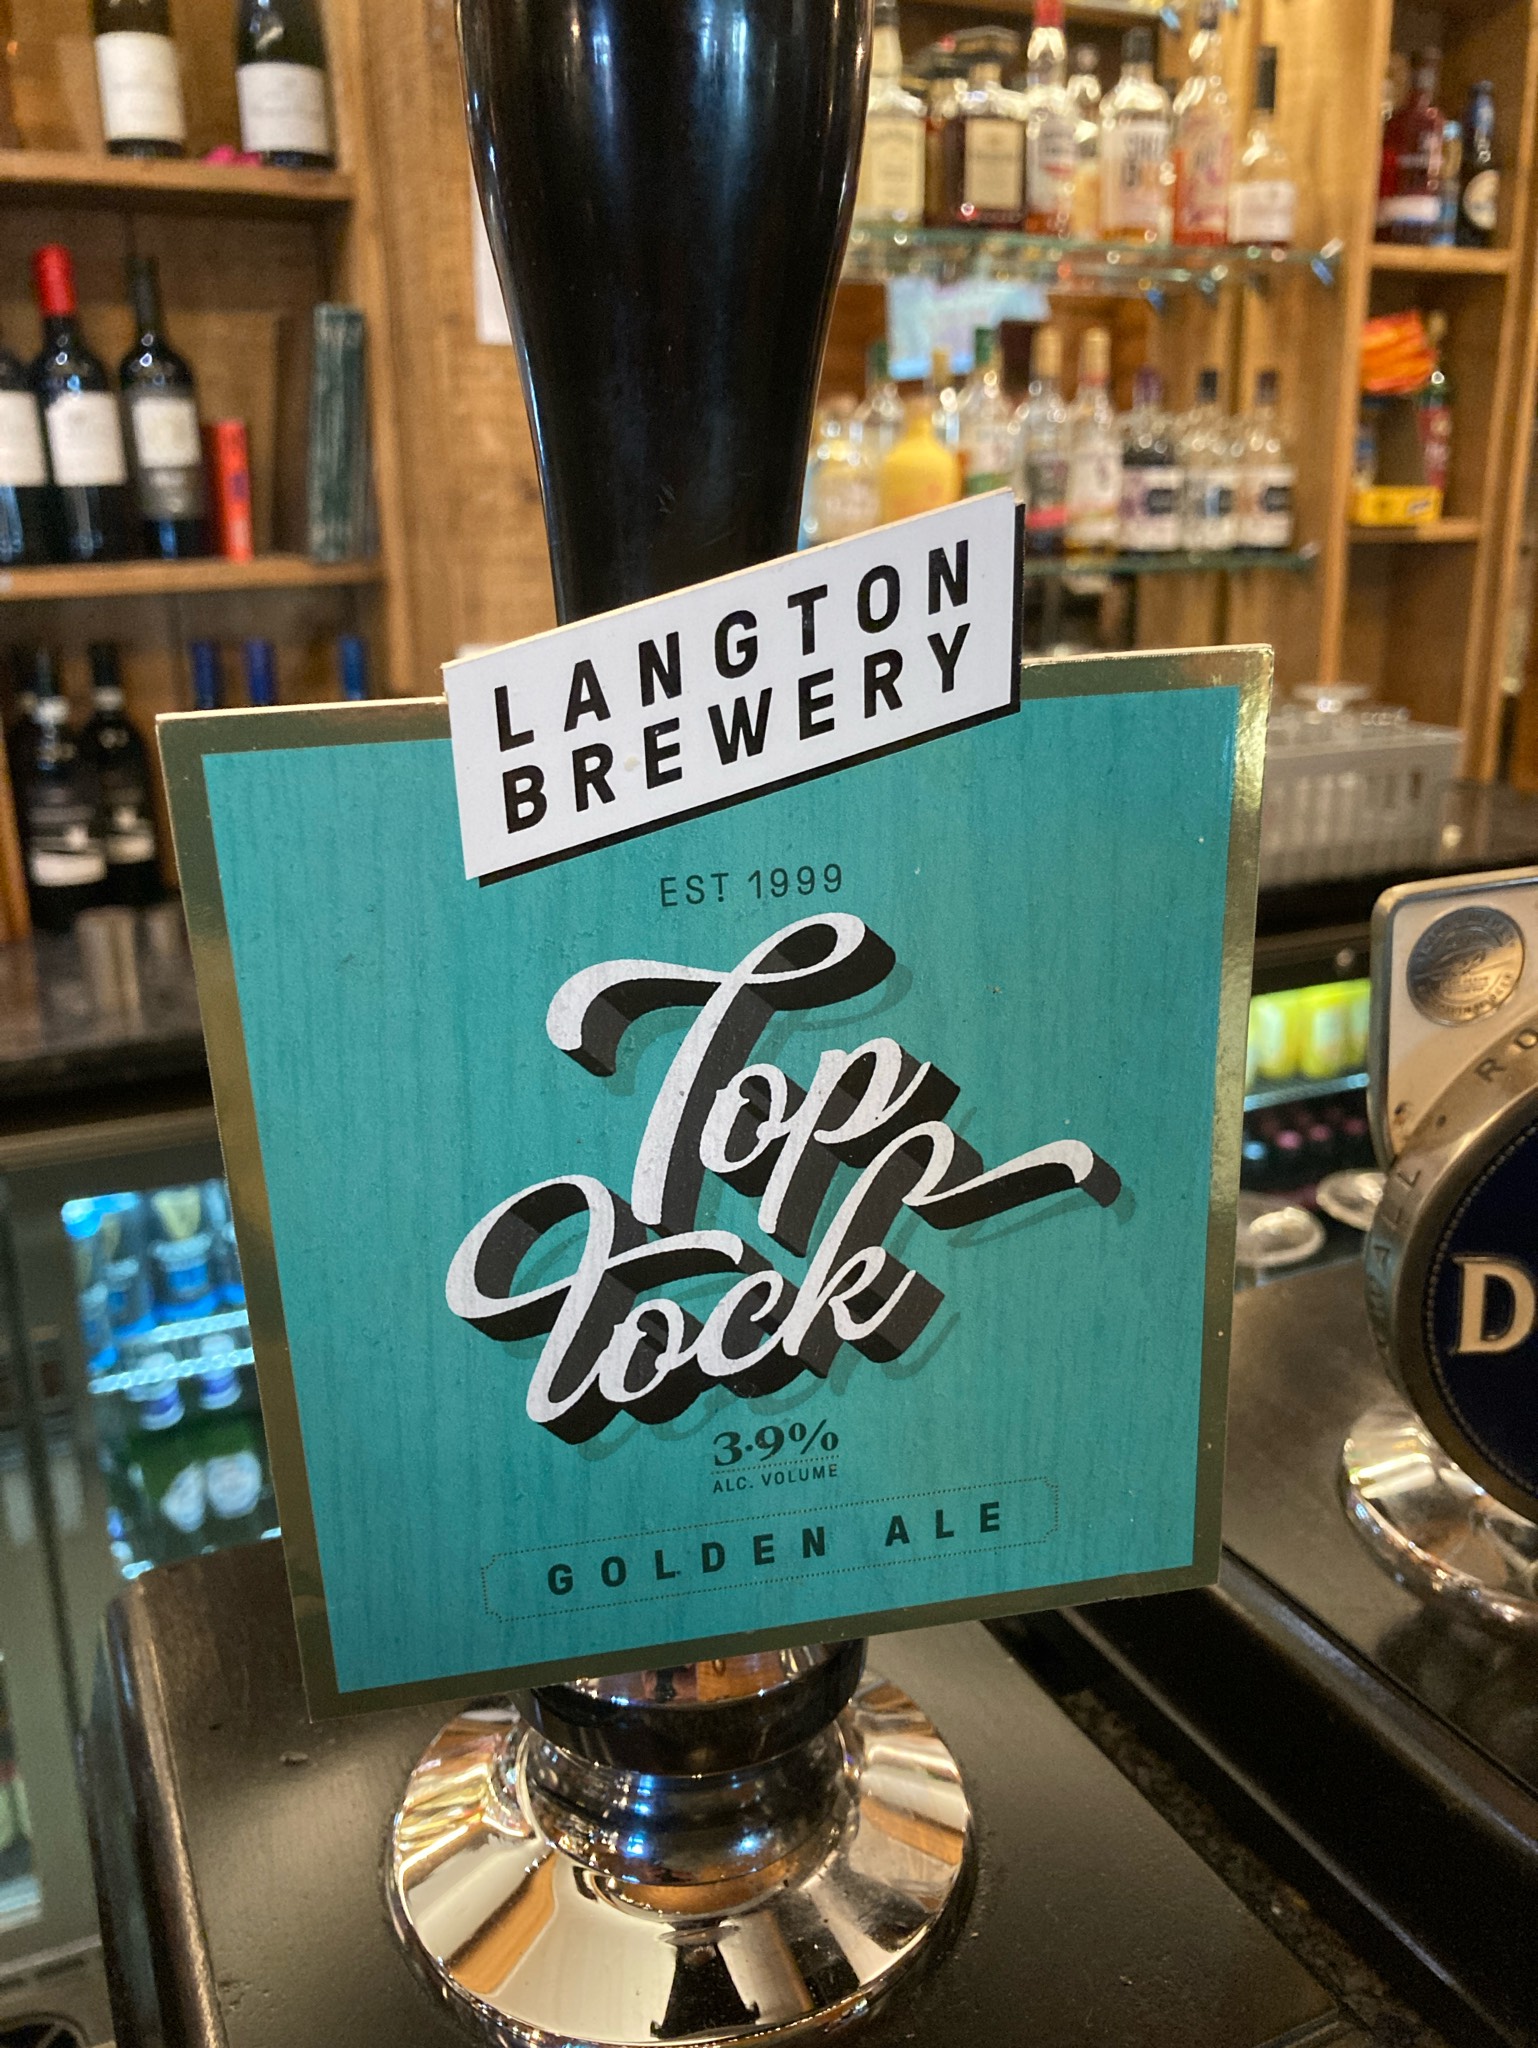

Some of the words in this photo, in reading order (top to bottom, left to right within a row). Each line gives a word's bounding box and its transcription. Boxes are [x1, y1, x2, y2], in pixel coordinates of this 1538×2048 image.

[494, 540, 970, 752] LANGTON
[501, 623, 971, 834] BREWERY
[747, 863, 843, 900] 1999
[546, 912, 960, 1257] Top
[446, 1121, 1121, 1444] Lock
[547, 1526, 827, 1597] GOLDEN
[884, 1501, 1001, 1547] ALE
[712, 1476, 754, 1494] ALC.
[761, 1463, 838, 1487] VOLUME
